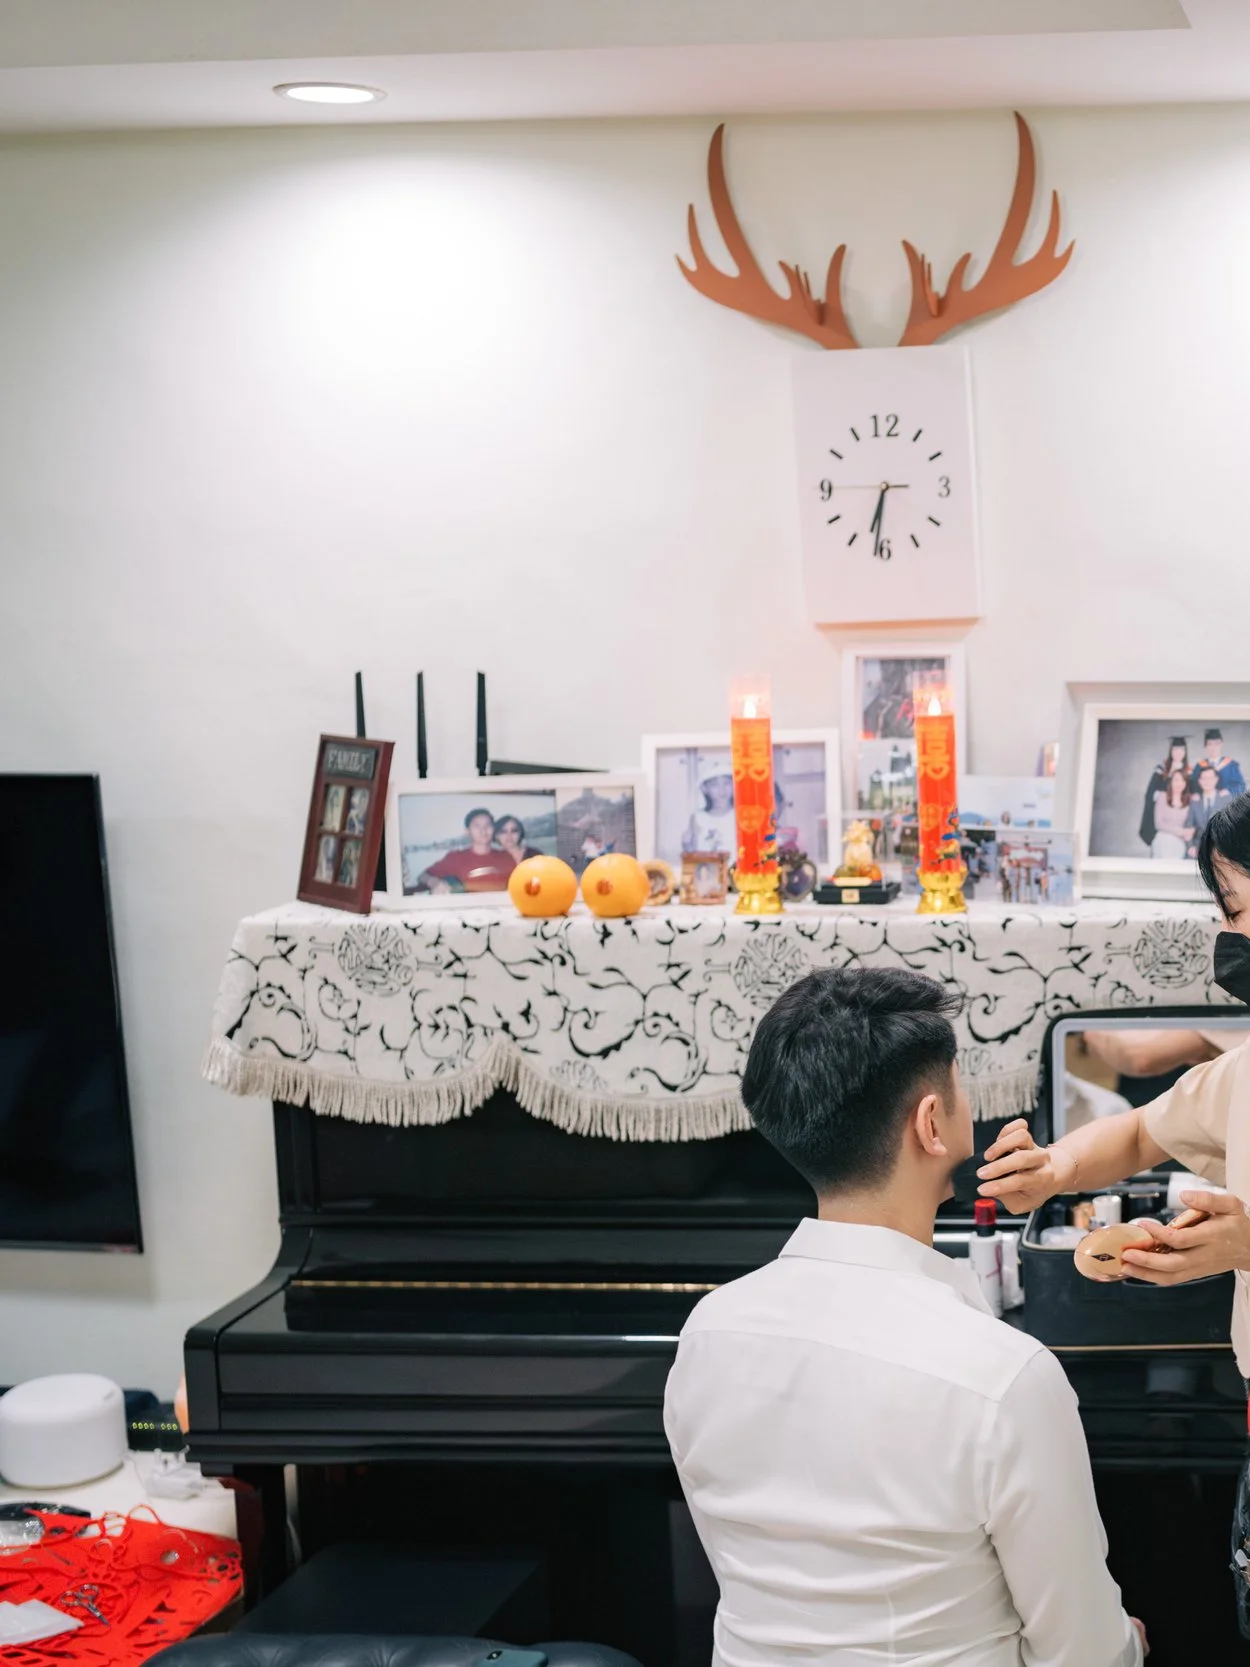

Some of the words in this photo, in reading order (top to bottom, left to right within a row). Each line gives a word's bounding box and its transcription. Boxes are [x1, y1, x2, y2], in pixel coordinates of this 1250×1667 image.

[870, 414, 899, 438] 12
[819, 478, 833, 501] 9
[938, 475, 951, 498] 3
[879, 538, 892, 560] 6
